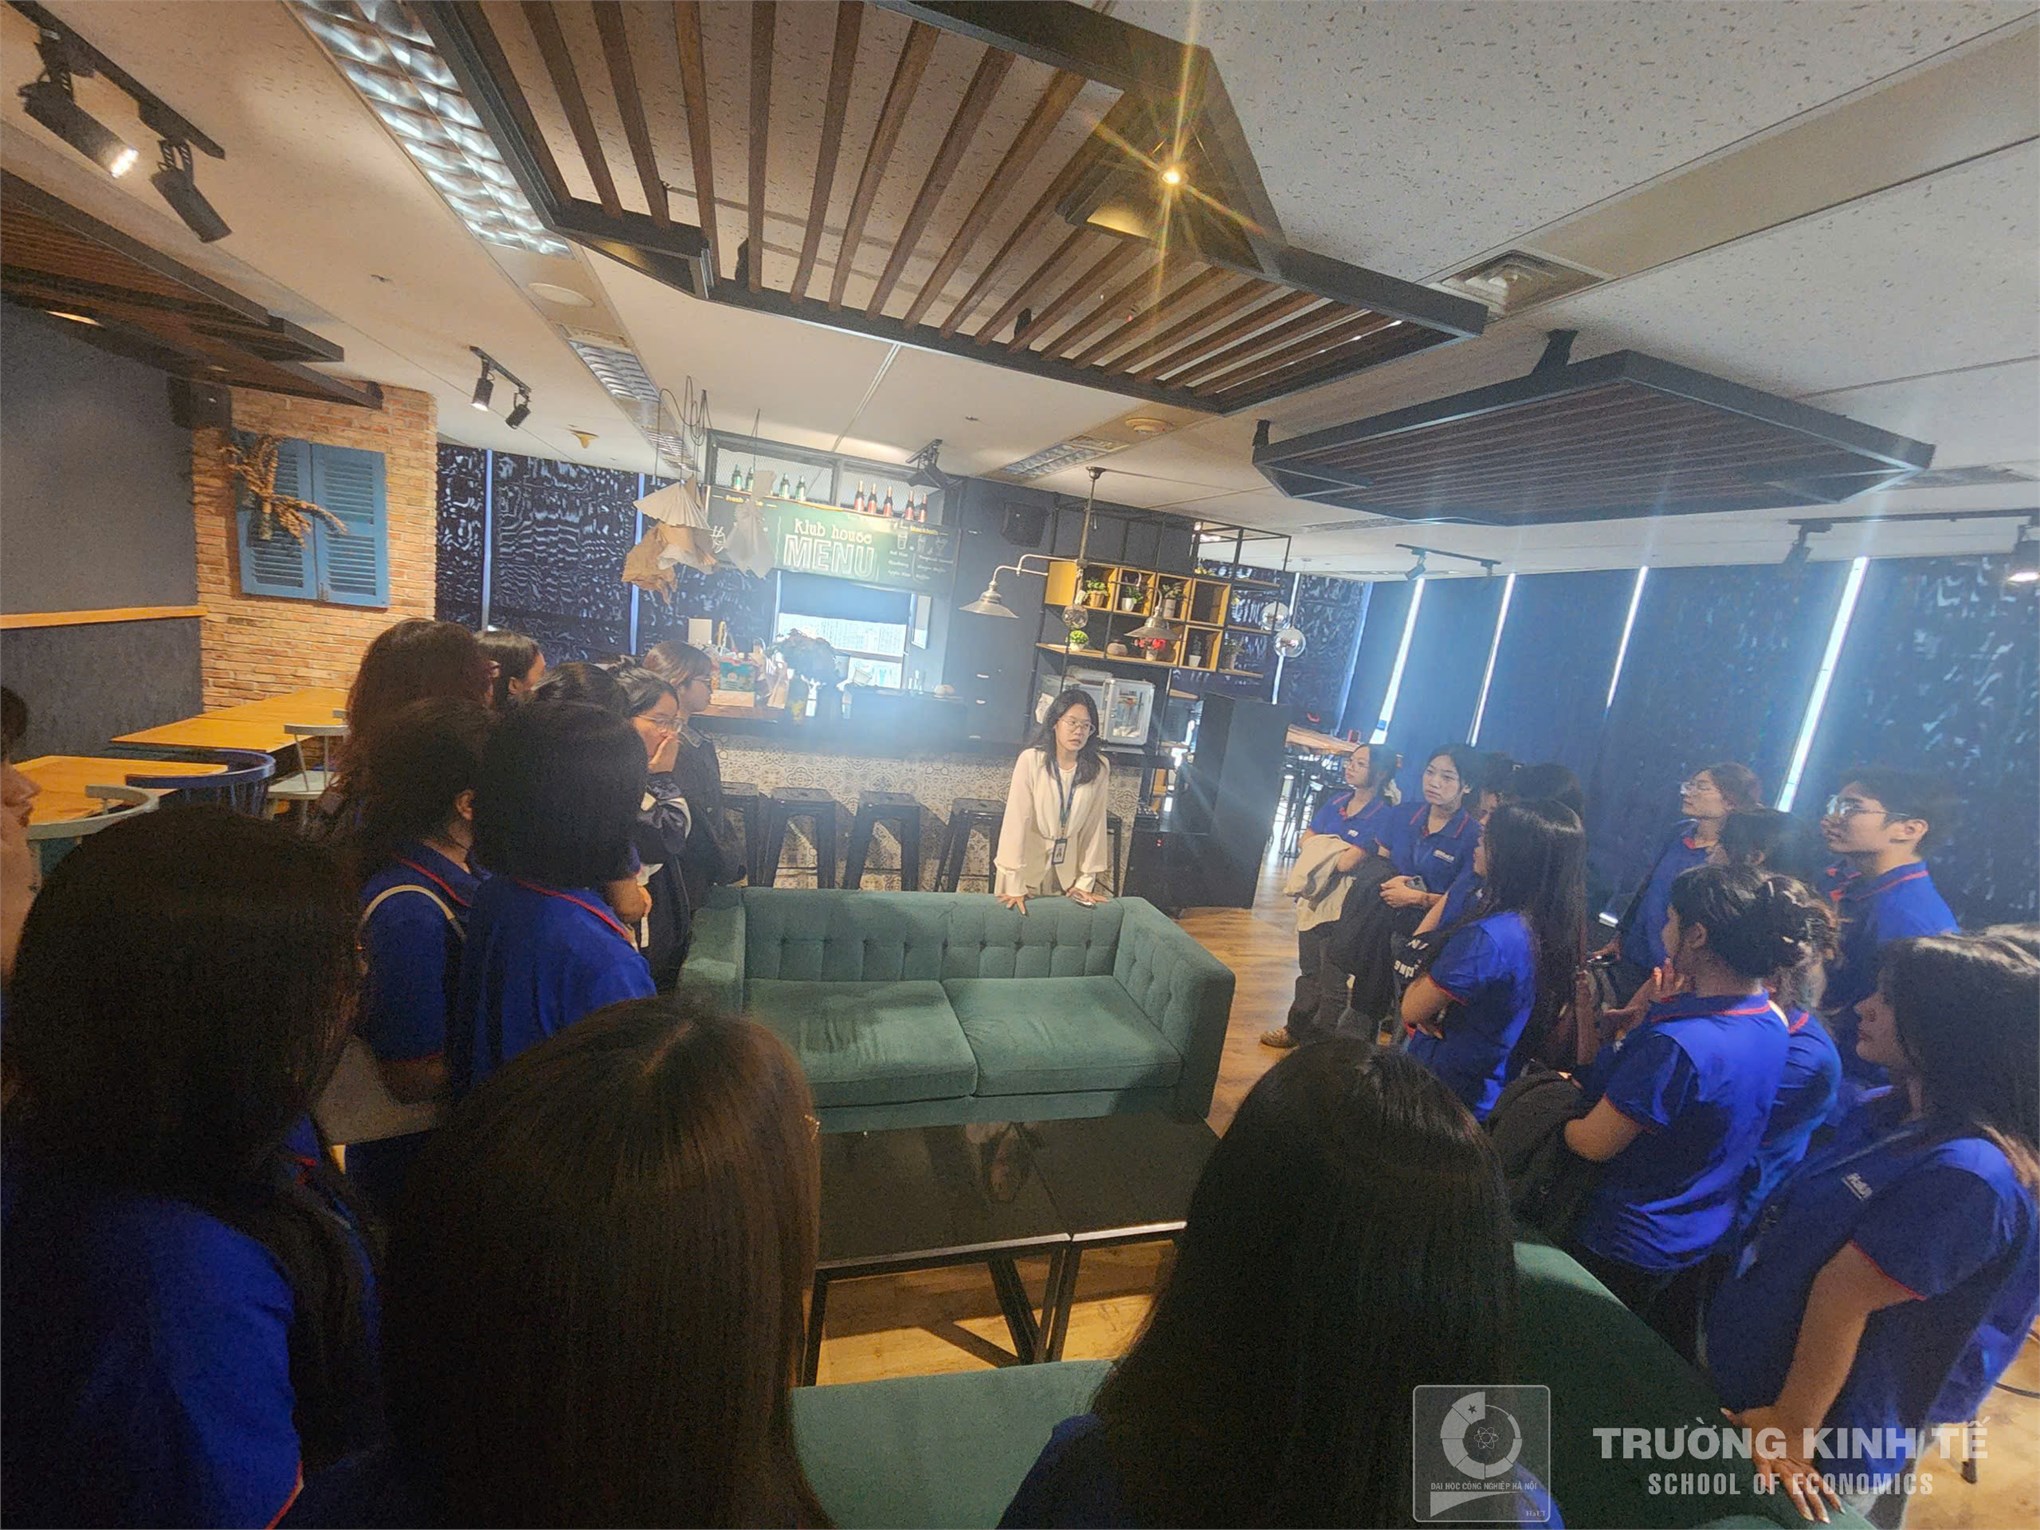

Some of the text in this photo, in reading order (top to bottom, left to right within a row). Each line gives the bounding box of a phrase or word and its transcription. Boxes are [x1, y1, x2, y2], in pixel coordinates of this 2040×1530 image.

[794, 518, 872, 544] Klub house
[783, 534, 875, 578] MENU
